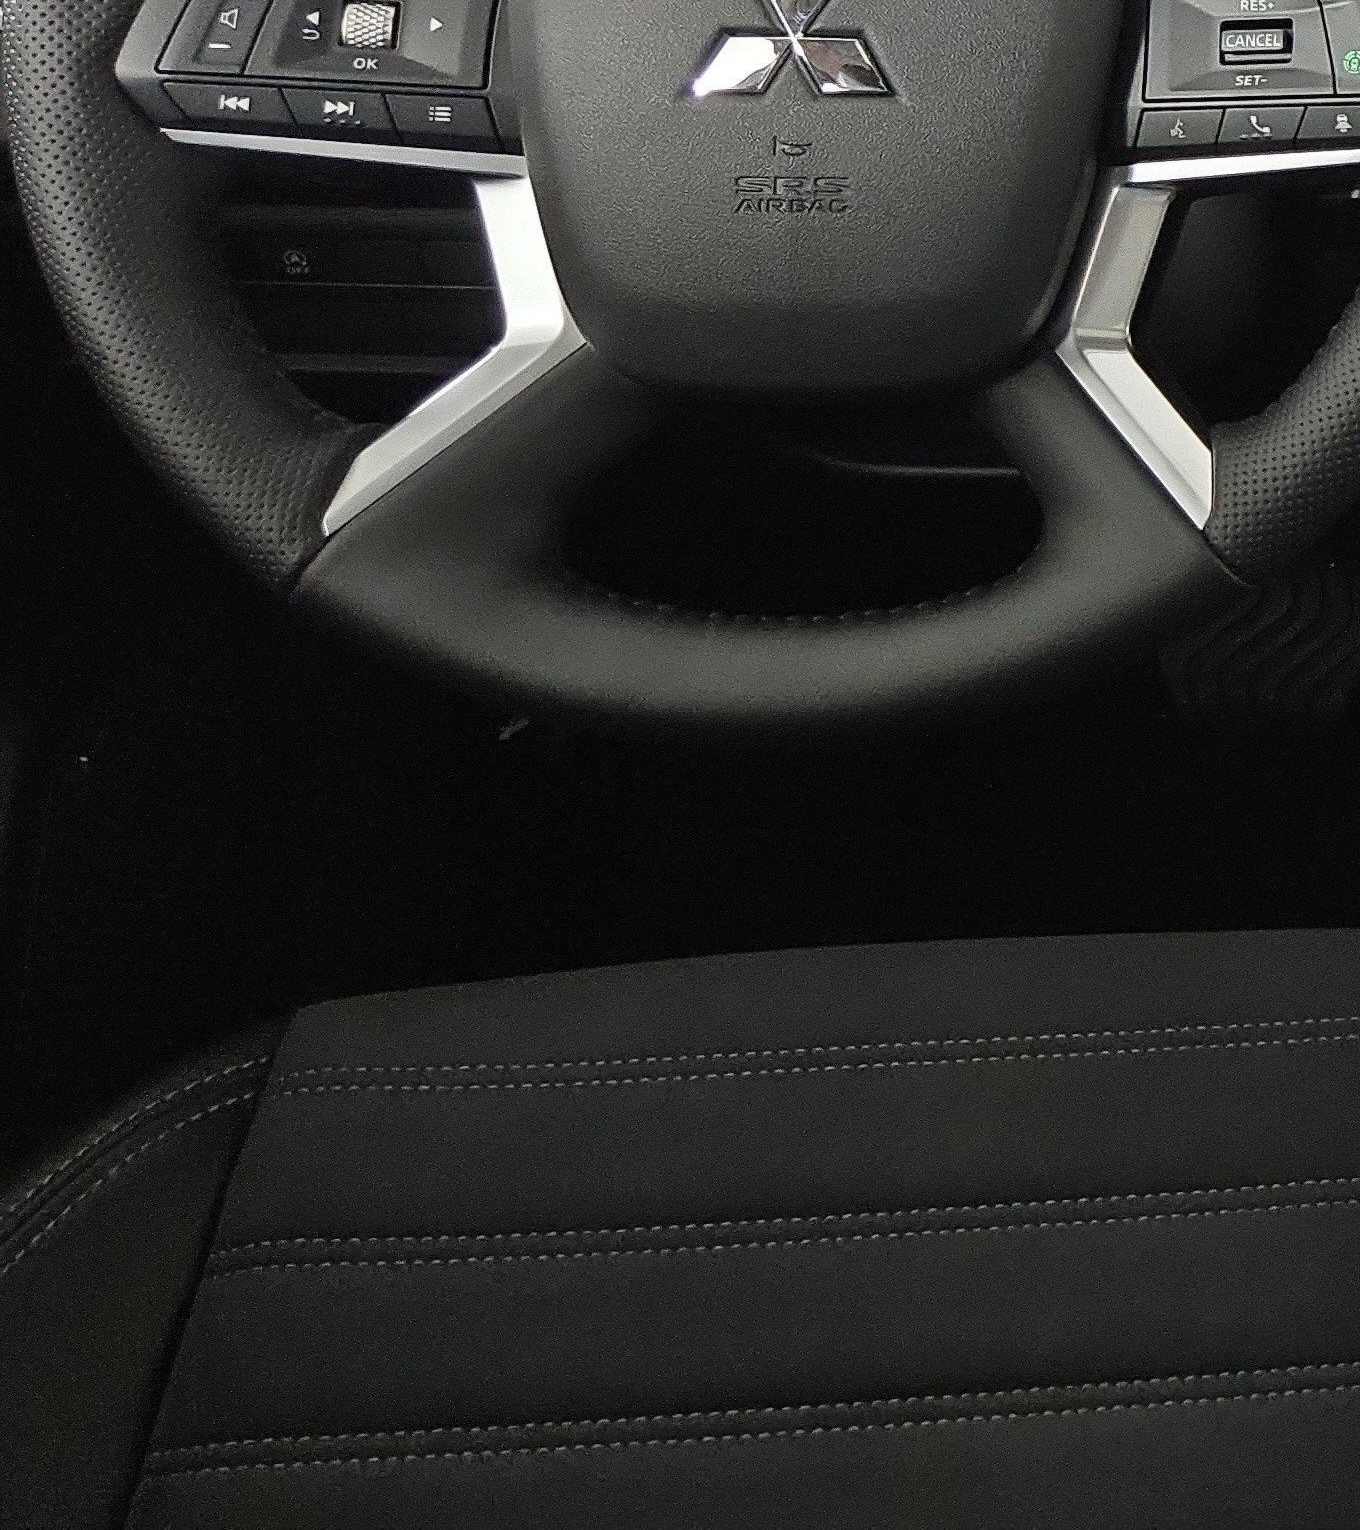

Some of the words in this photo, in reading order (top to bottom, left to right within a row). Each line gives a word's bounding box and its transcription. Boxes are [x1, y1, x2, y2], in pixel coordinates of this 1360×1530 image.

[1240, 0, 1275, 12] RES+
[1225, 33, 1282, 49] CANCEL
[353, 57, 379, 71] OK
[1235, 74, 1268, 88] SET-
[734, 175, 850, 196] SRS
[733, 198, 850, 215] AIRBAG
